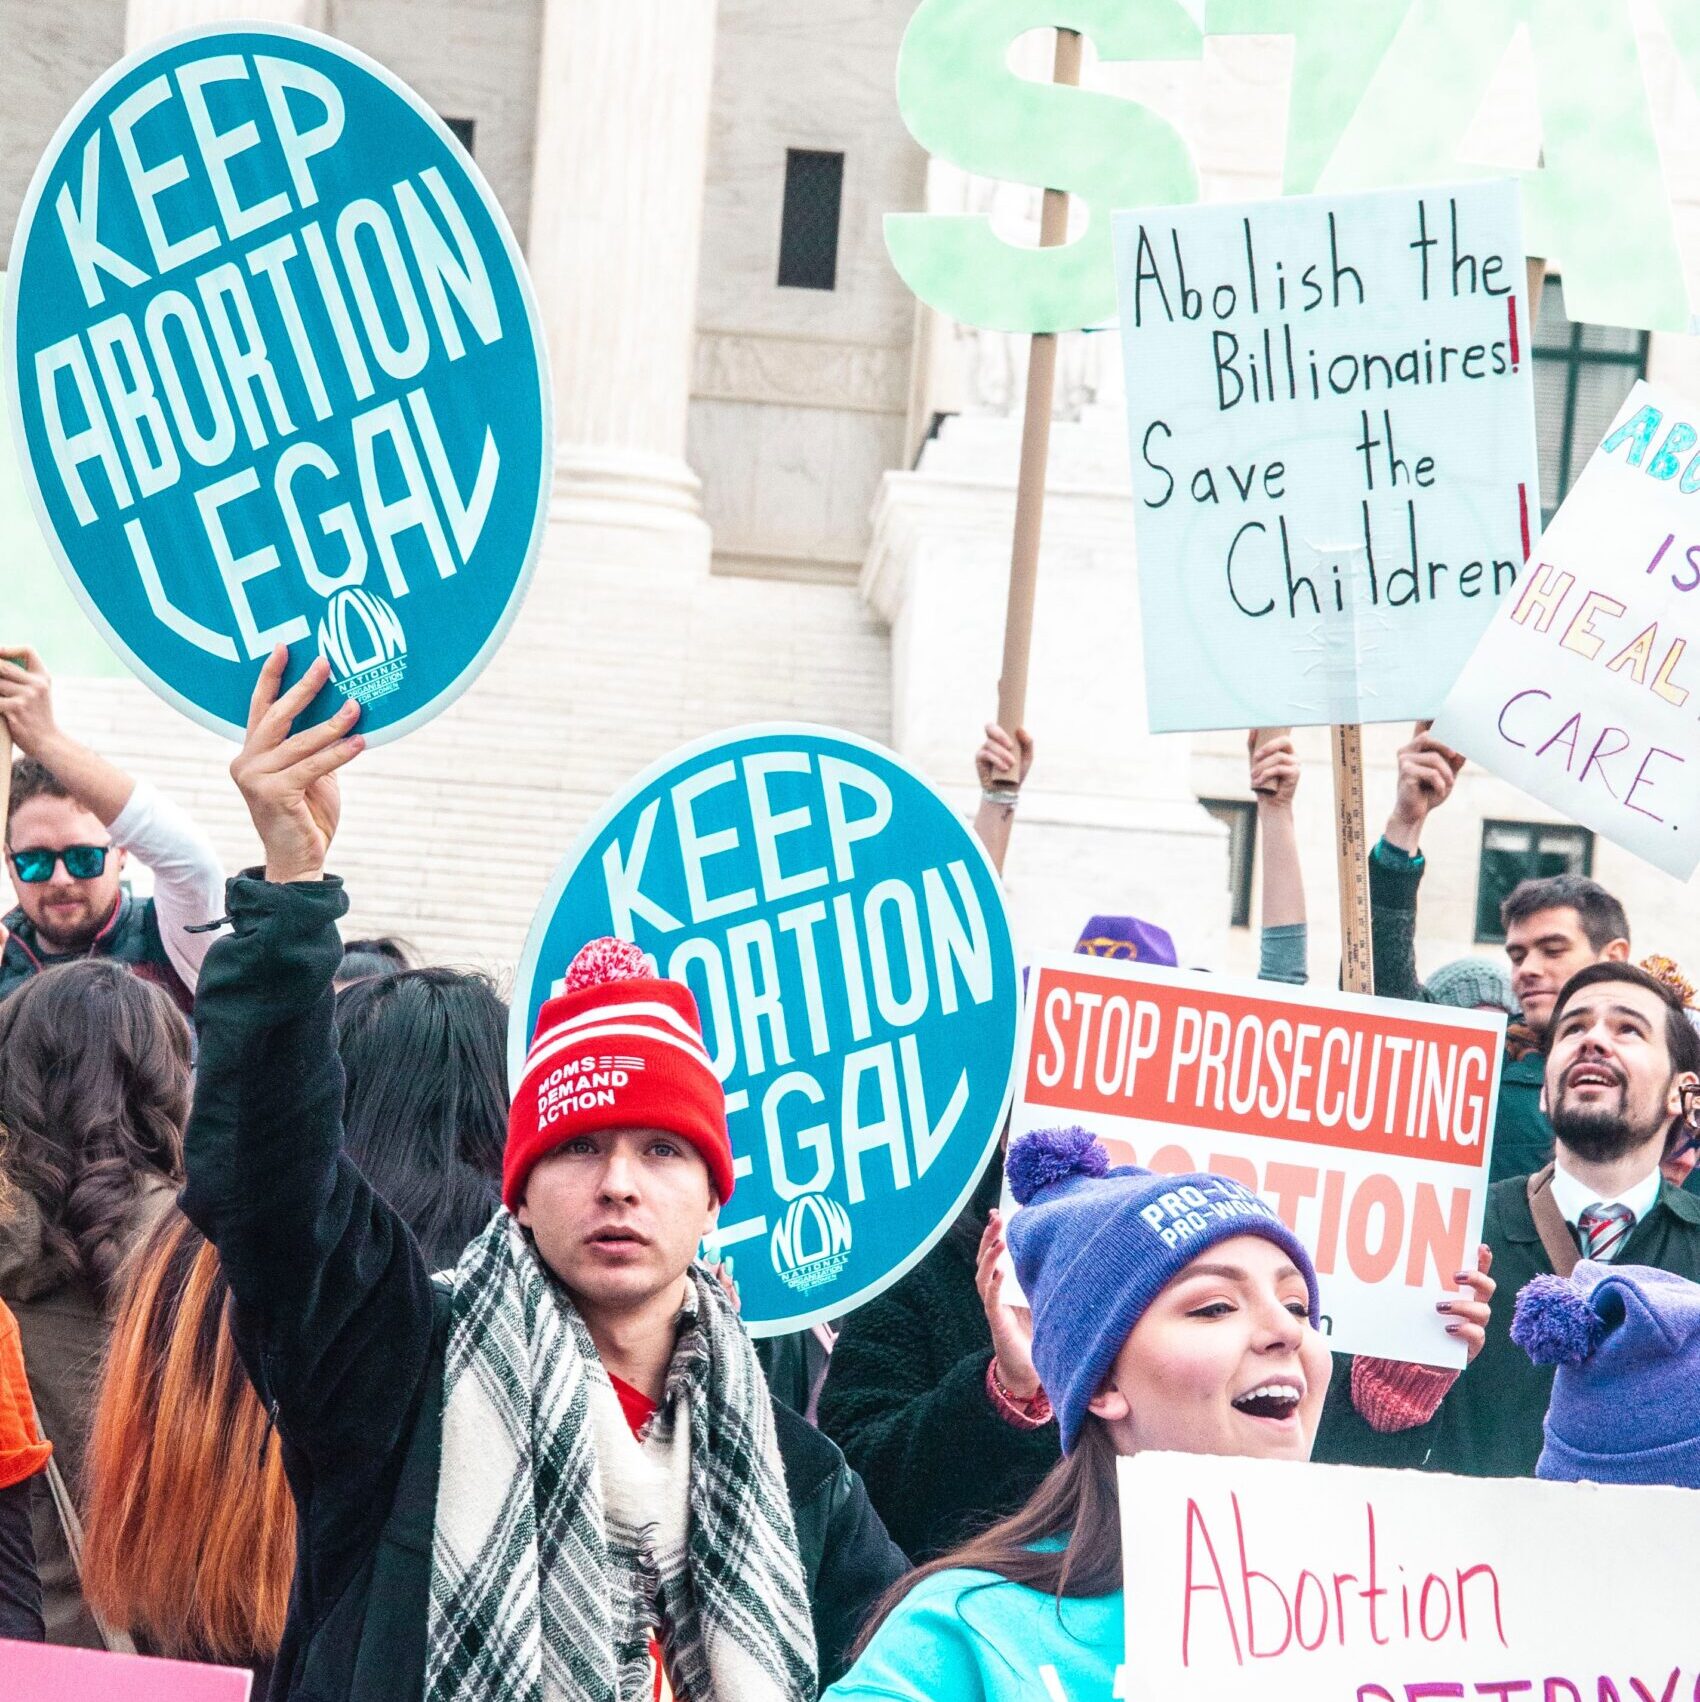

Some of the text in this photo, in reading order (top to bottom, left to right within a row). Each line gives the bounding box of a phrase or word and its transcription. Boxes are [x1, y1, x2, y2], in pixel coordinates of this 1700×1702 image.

[55, 54, 346, 308] KEEP
[883, 0, 1700, 333] STA
[1134, 198, 1513, 328] Abolish the
[34, 167, 503, 527] ABORTION
[1211, 294, 1521, 412] Billionaires!
[1141, 408, 1437, 509] Save the
[123, 388, 500, 663] LEGAL
[1226, 482, 1531, 619] Children!
[318, 588, 407, 684] NOW
[338, 659, 407, 693] NATIONAL
[347, 671, 403, 700] ORGANIZATION
[372, 682, 399, 698] WOMEN
[1510, 562, 1692, 708] HEAL
[1497, 688, 1686, 830] CARE.
[601, 751, 893, 943] KEEP
[640, 860, 993, 1084] ORTION
[537, 1070, 629, 1115] DEMAND
[537, 1088, 616, 1133] ACTION
[538, 1056, 596, 1096] MOMS
[1036, 986, 1488, 1147] STOP PROSECUTING
[771, 1194, 852, 1274] NOW
[1098, 1136, 1472, 1294] TION
[1139, 1178, 1259, 1233] PRO-LI
[1159, 1199, 1283, 1250] PRO-WOMA
[781, 1255, 848, 1281] NATIONAL
[1181, 1490, 1509, 1668] Abortion
